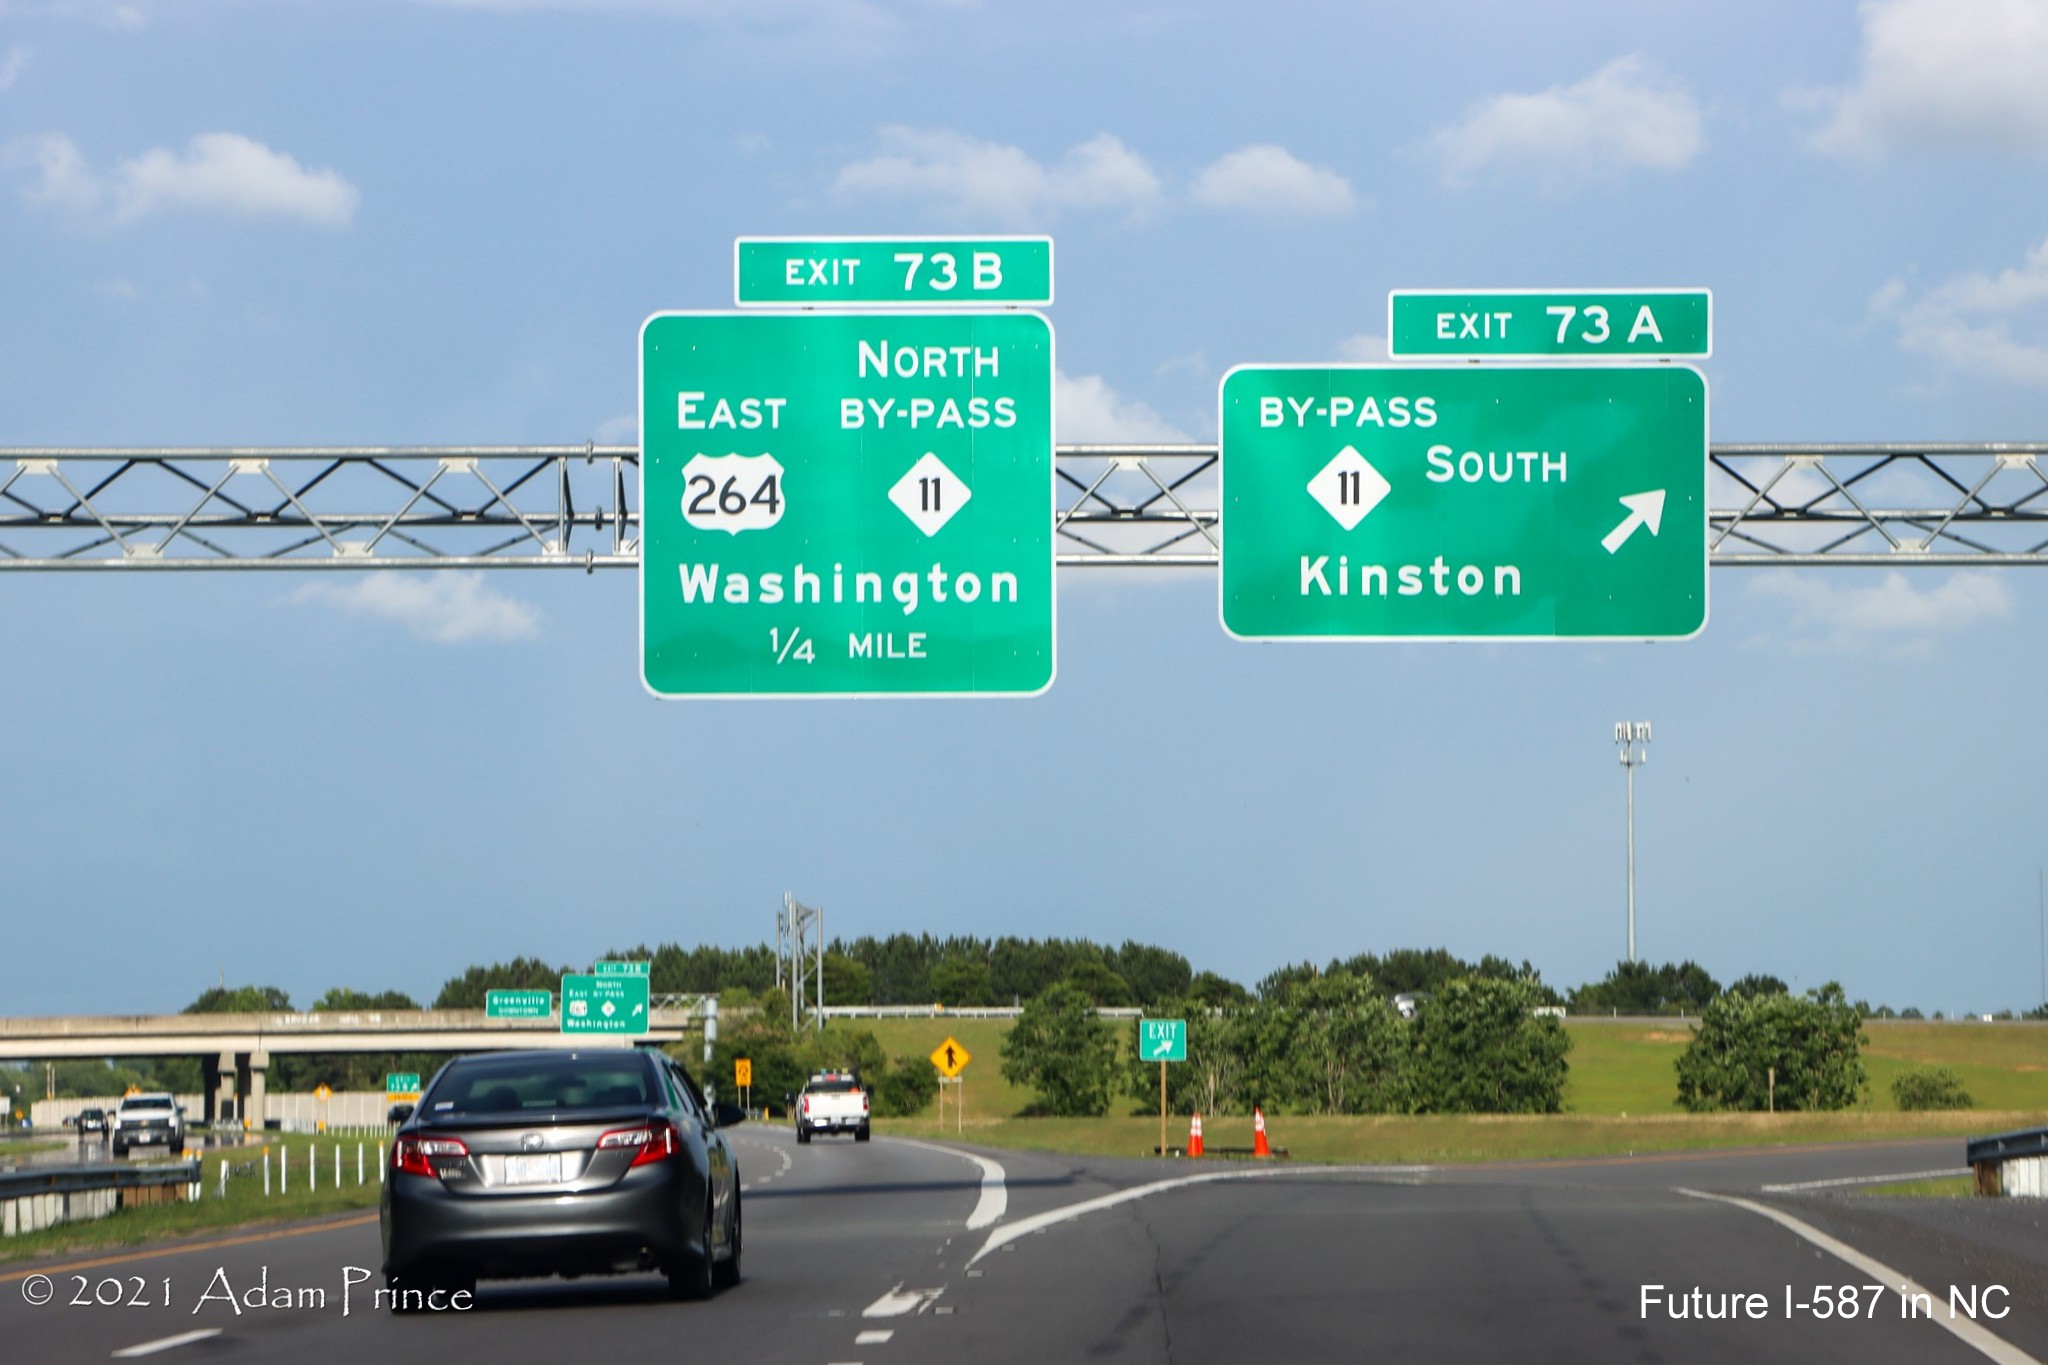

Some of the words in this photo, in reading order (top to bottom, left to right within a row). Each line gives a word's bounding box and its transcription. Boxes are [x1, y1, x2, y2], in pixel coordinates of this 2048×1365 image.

[786, 259, 861, 285] EXIT
[1437, 312, 1512, 339] EXIT
[858, 340, 999, 378] NORTH
[678, 391, 787, 429] EAST
[840, 397, 1017, 429] BY-PASS
[1260, 396, 1438, 427] BY-PASS
[1426, 445, 1567, 483] SOUTH
[688, 474, 780, 515] 264
[918, 477, 941, 512] 11
[1337, 471, 1361, 506] 11
[679, 562, 1018, 616] Washington
[1300, 556, 1521, 596] Kinston
[848, 632, 927, 658] MILE
[492, 995, 545, 1006] Greenville
[567, 1019, 626, 1030] Washington
[1149, 1022, 1177, 1040] EXIT
